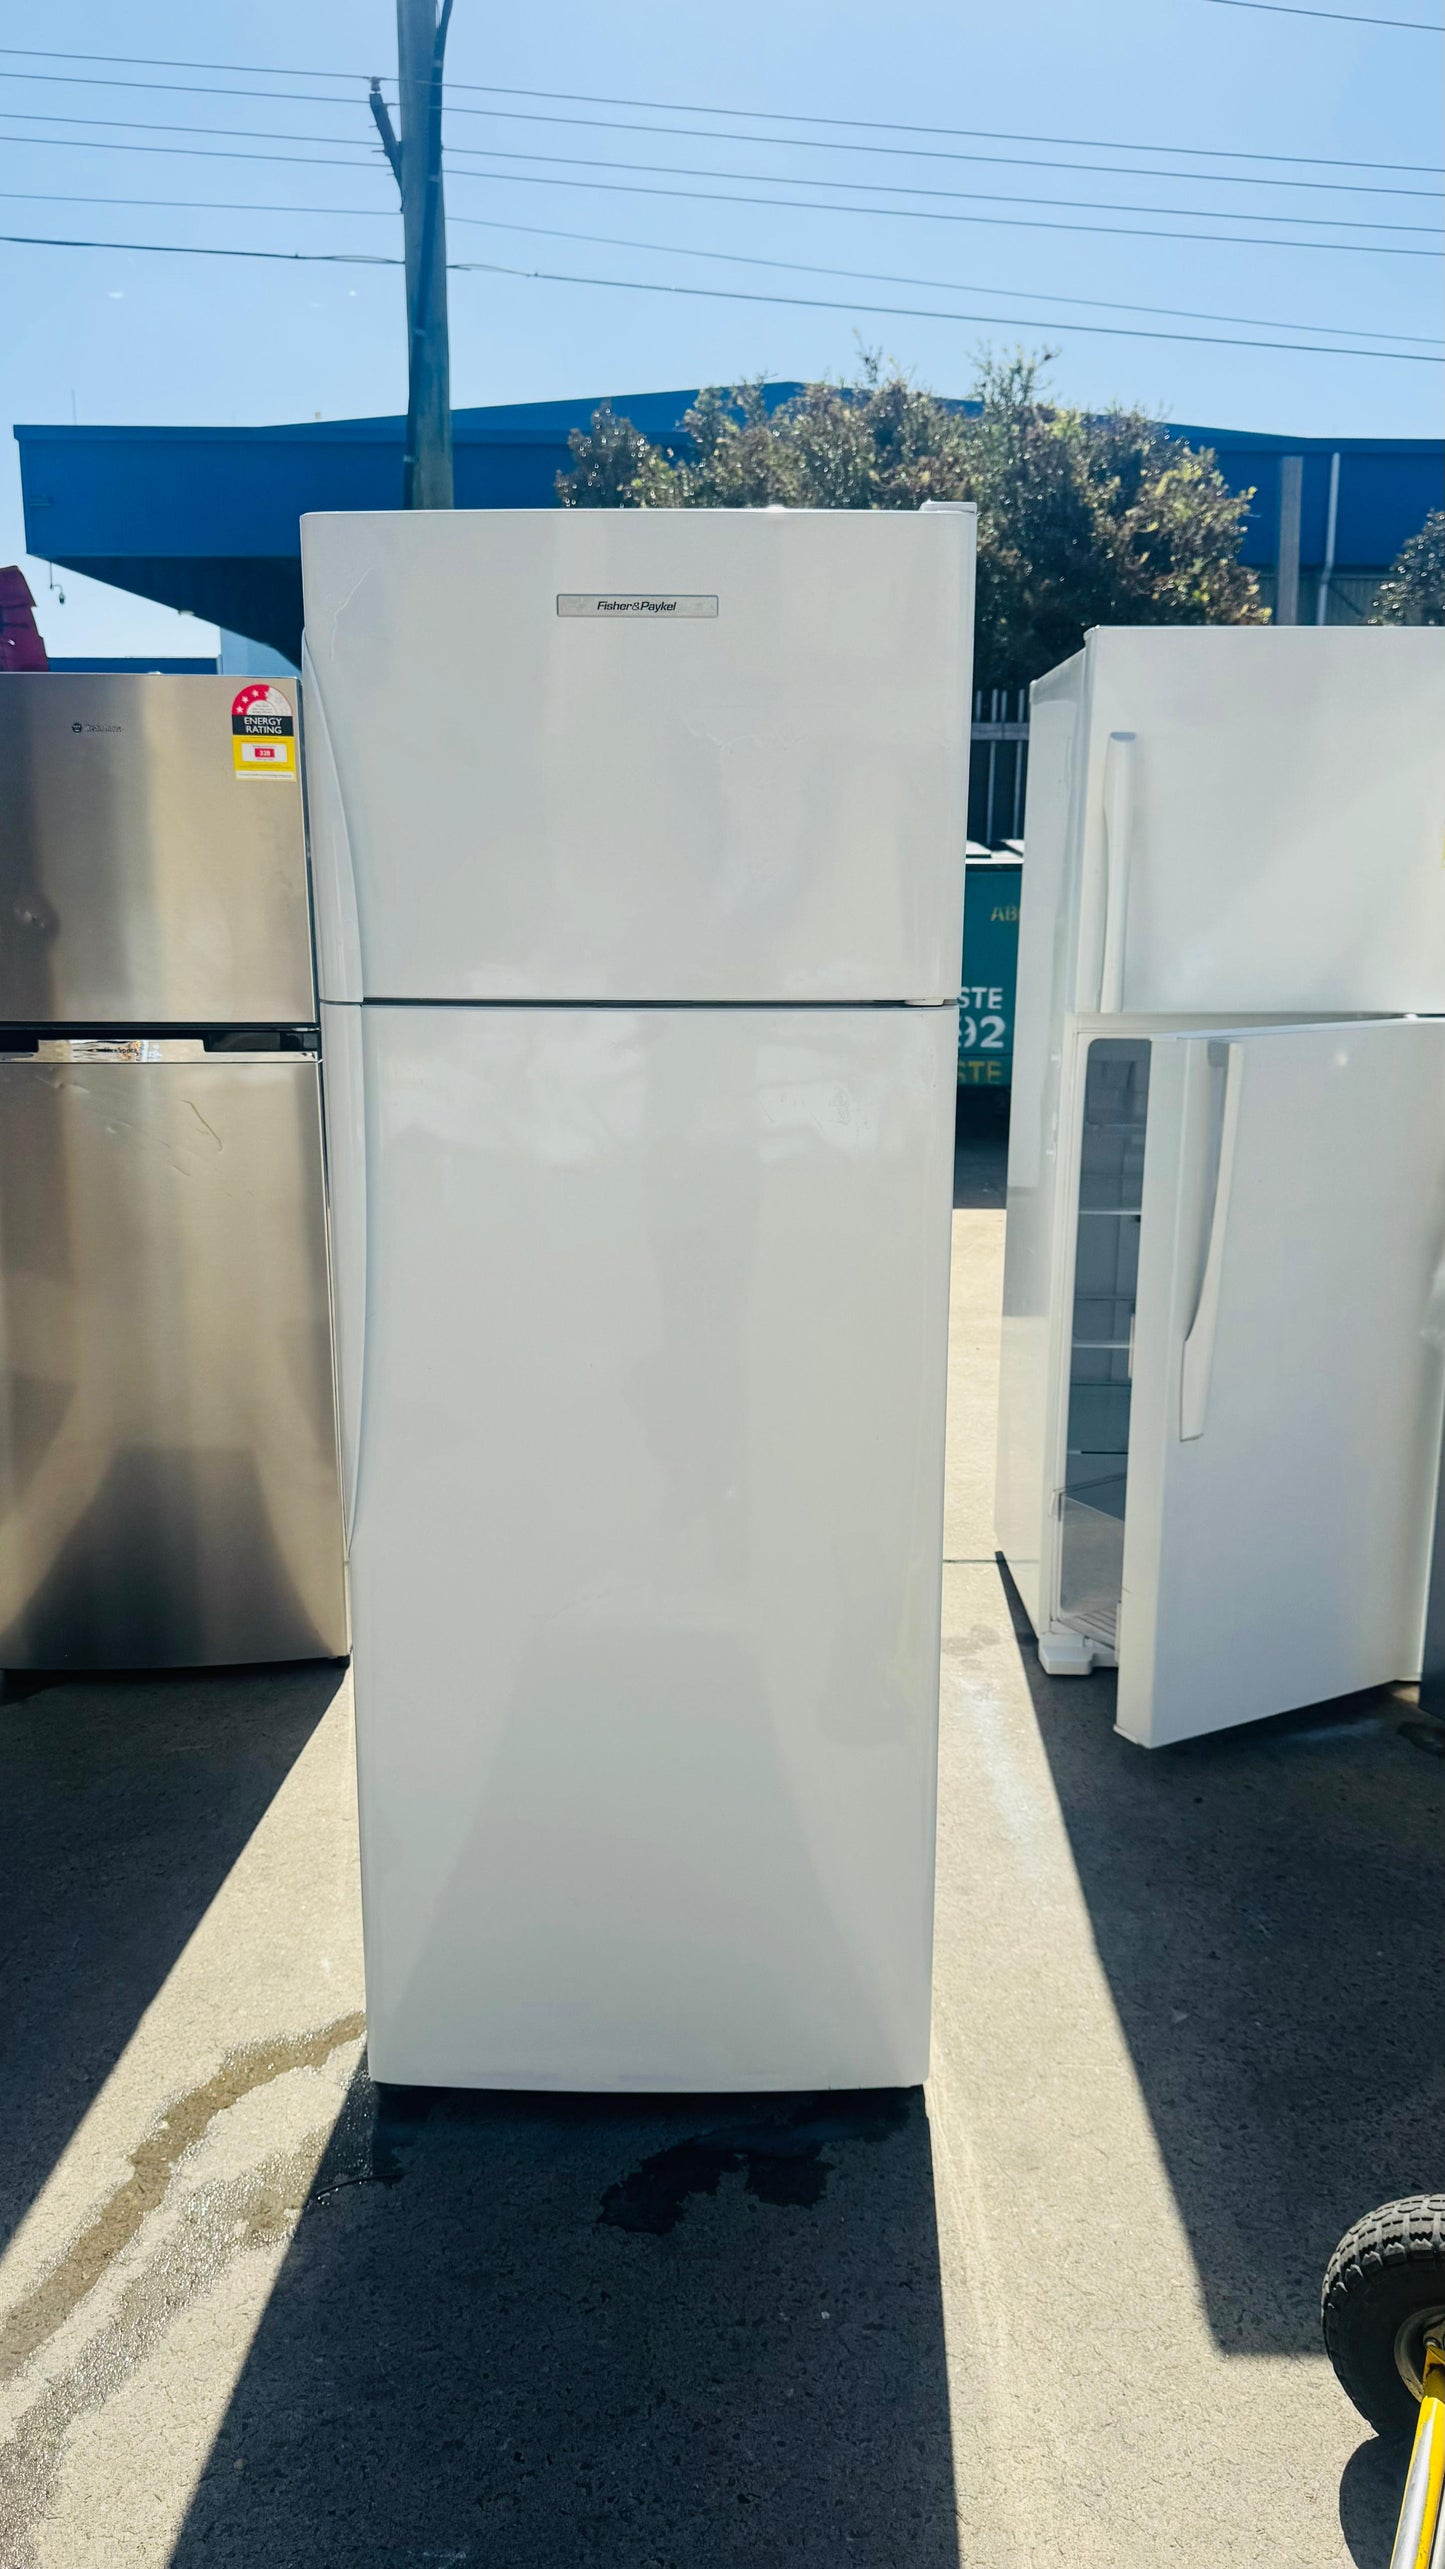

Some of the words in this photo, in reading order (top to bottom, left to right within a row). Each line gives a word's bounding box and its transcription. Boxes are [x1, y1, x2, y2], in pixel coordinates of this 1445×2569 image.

[597, 601, 677, 613] Fisher&Paykel
[244, 717, 282, 726] ENERGY
[245, 725, 282, 734] RATING
